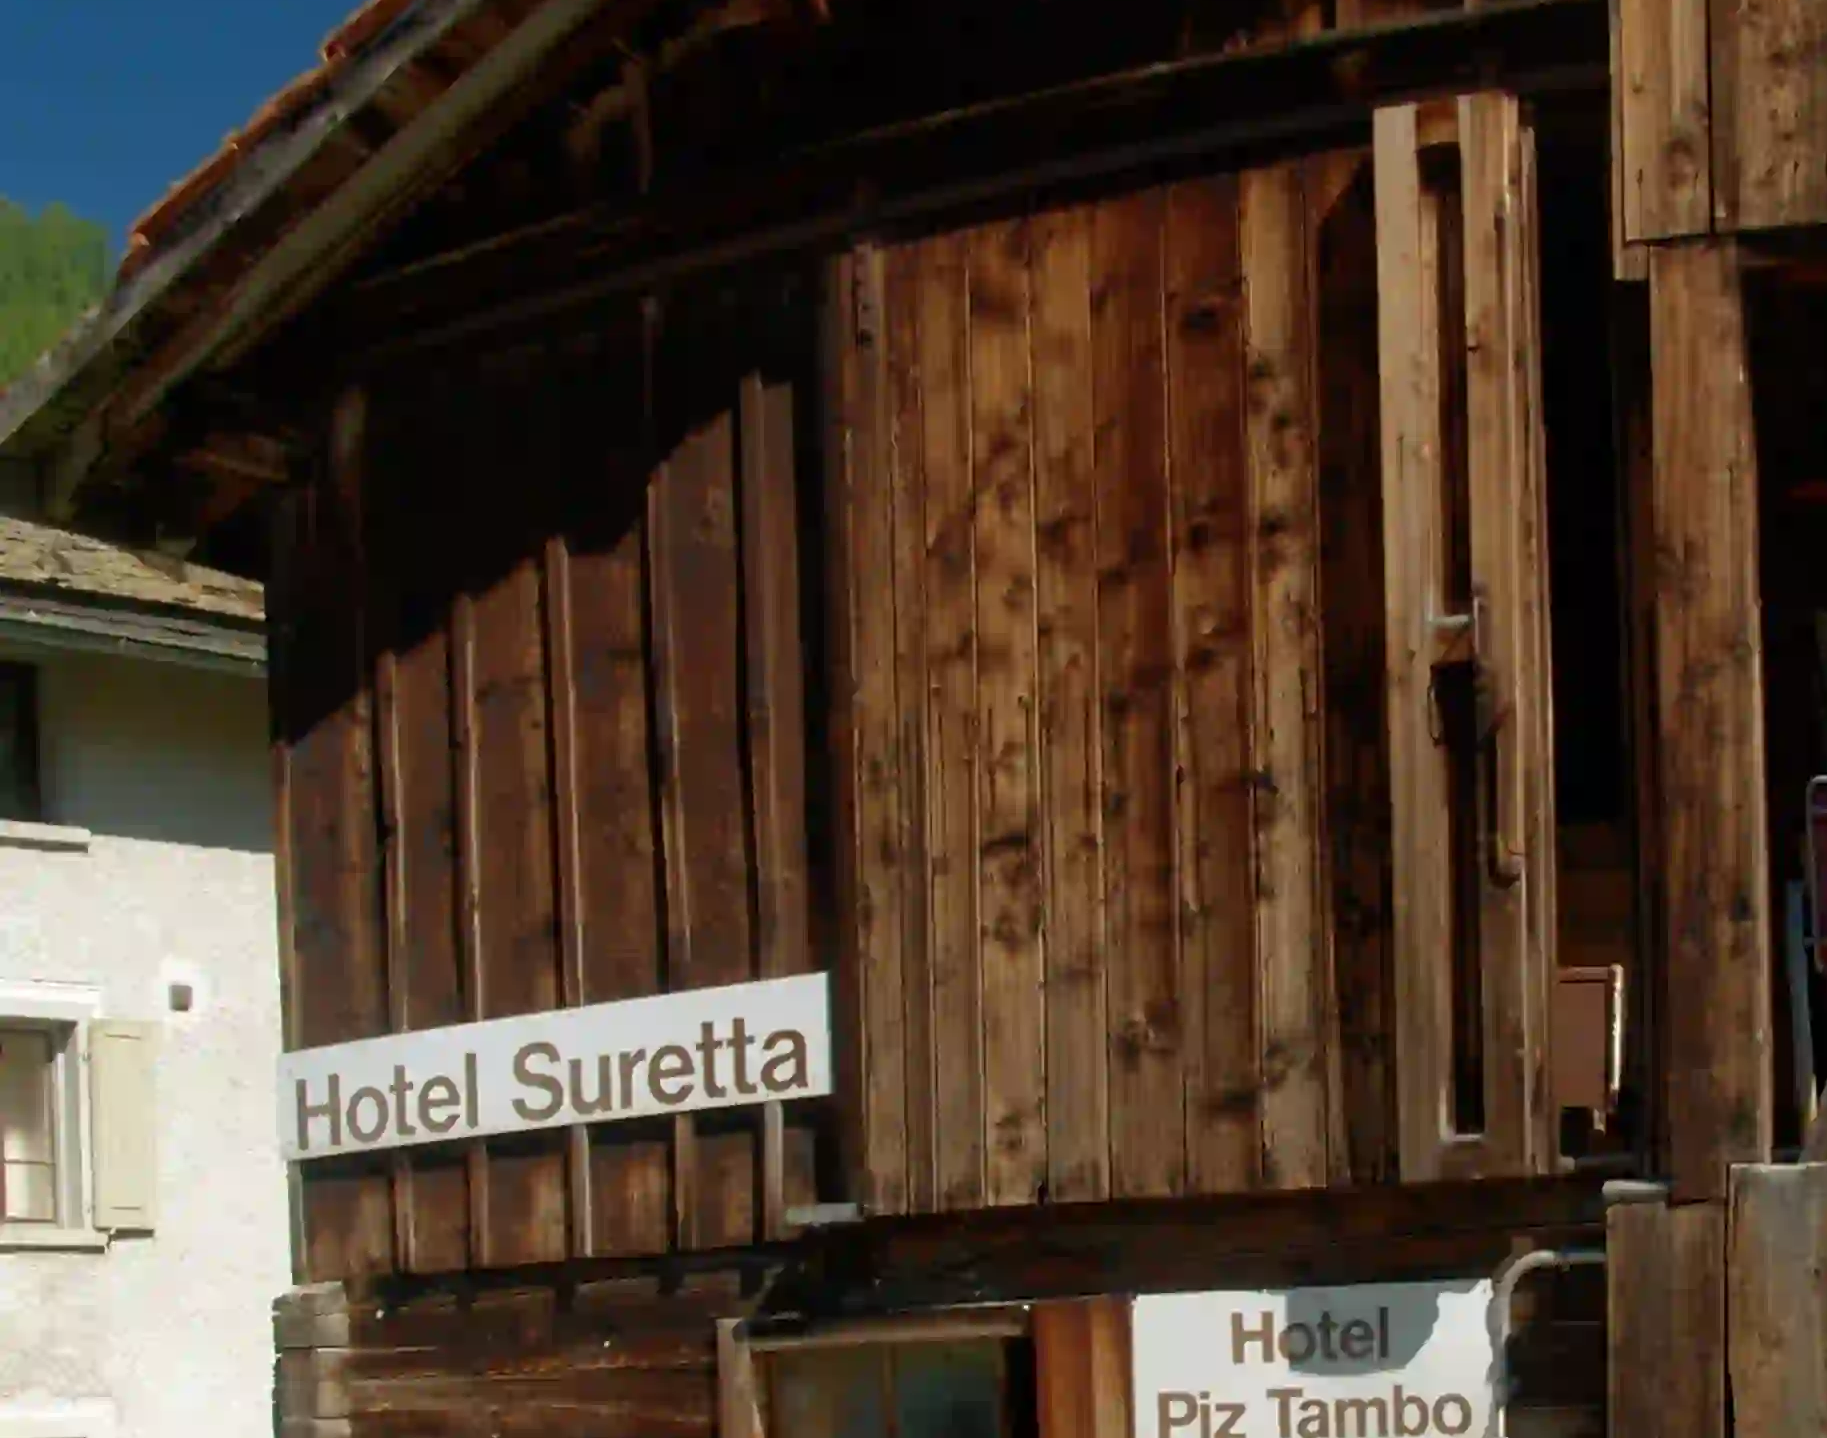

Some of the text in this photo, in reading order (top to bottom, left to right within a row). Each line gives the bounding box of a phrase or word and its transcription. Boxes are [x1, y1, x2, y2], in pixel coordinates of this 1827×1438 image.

[295, 1017, 809, 1150] Hotel Suretta
[1231, 1306, 1389, 1364] Hotel
